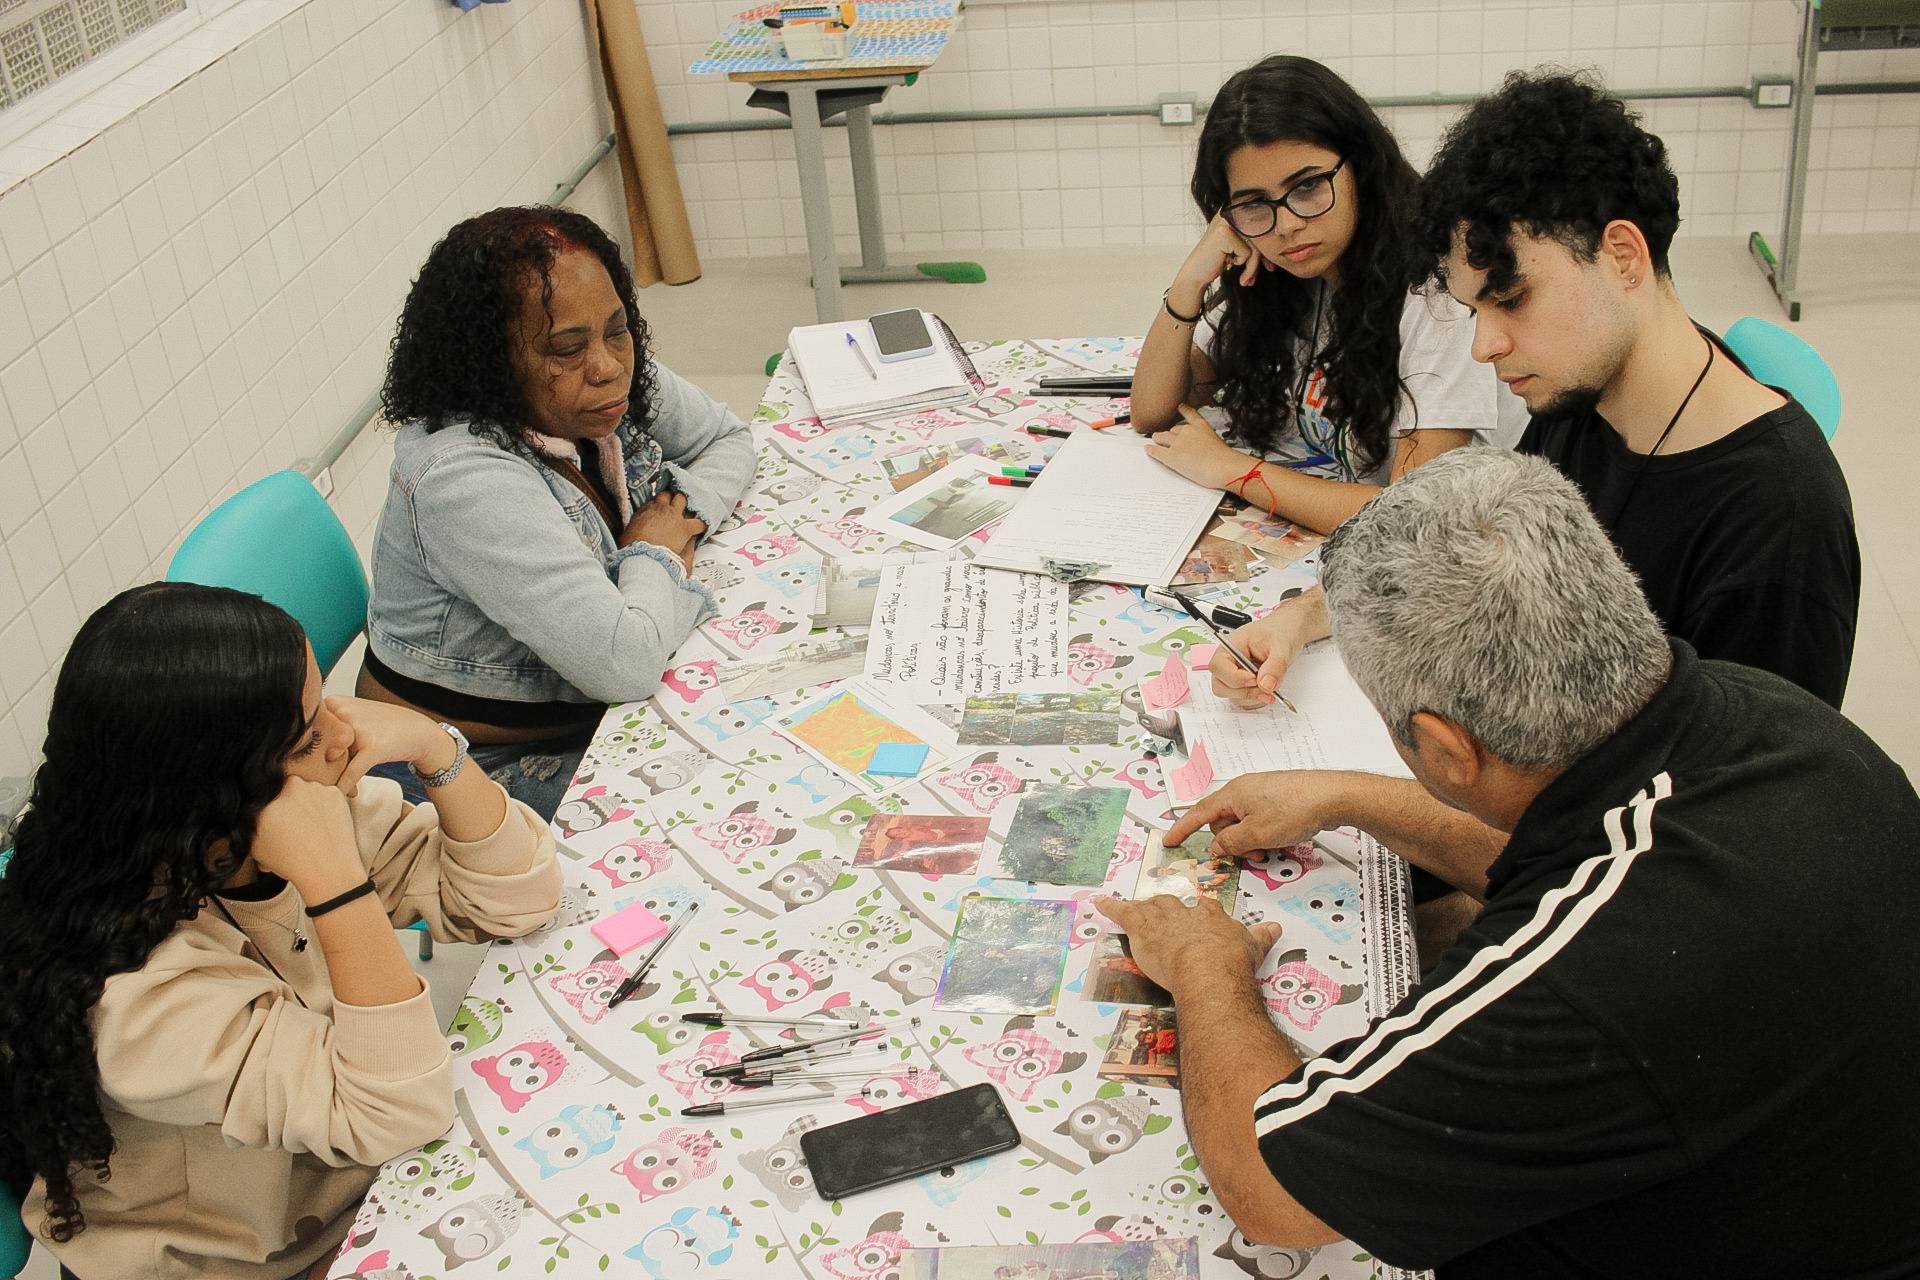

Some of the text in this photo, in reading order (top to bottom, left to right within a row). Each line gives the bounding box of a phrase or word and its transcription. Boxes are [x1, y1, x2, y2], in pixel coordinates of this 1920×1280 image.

[951, 606, 970, 632] bairro
[936, 635, 948, 651] são
[1013, 637, 1023, 657] uma
[930, 656, 947, 685] Quais
[1008, 659, 1024, 685] Existe
[1027, 652, 1047, 679] projeto
[1050, 661, 1064, 677] que
